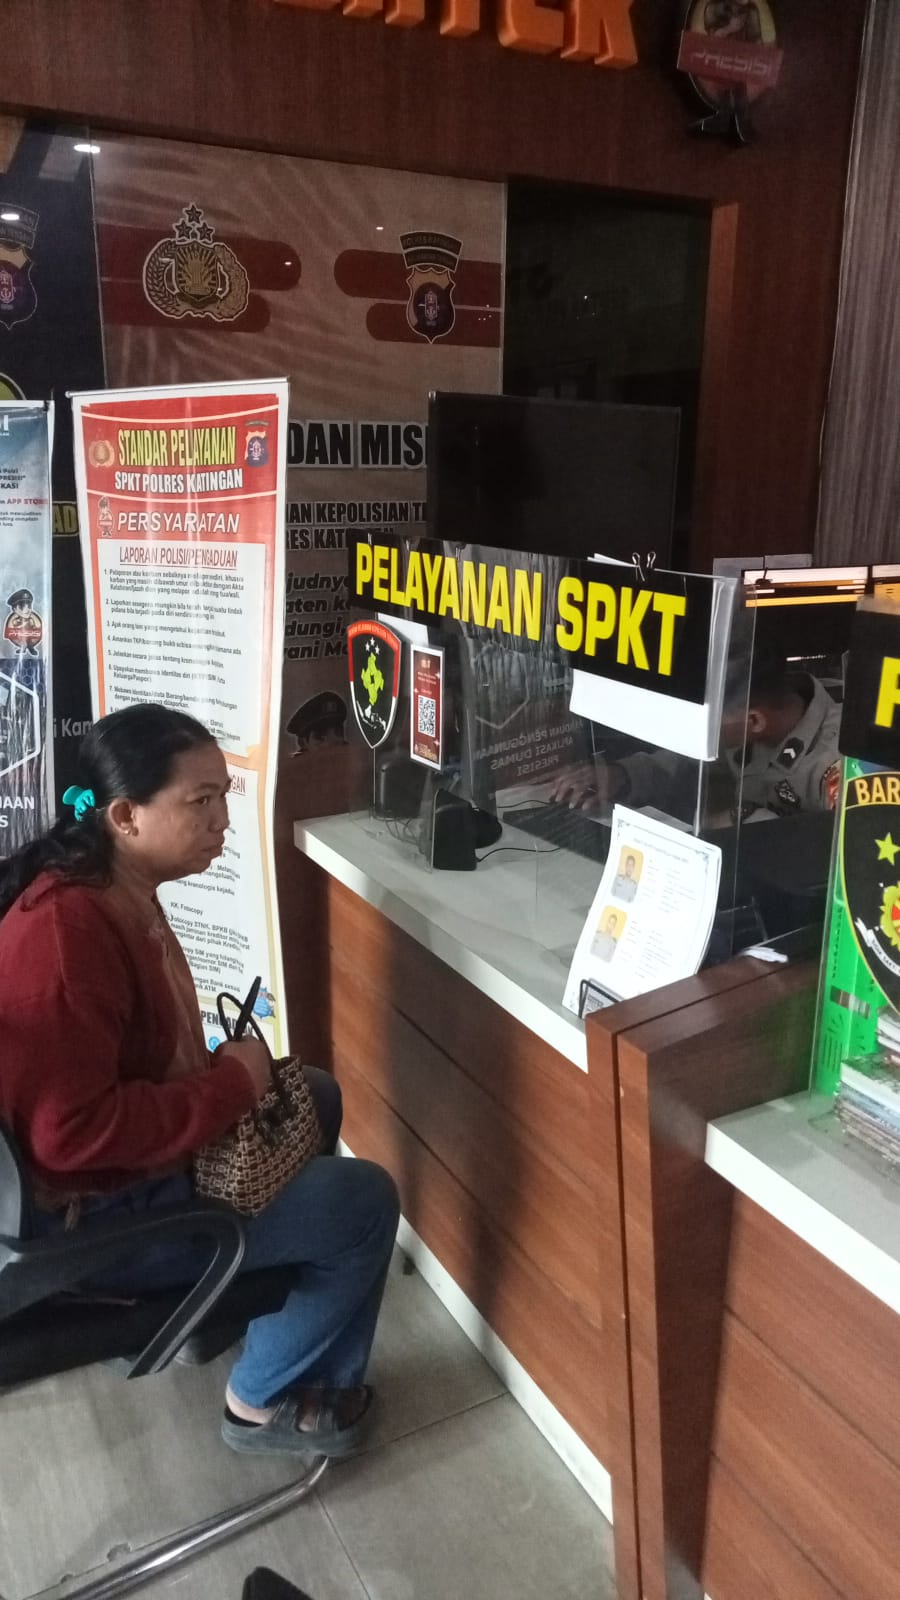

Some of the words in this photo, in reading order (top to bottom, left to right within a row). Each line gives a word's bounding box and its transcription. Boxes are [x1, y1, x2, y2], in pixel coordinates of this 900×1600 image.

[118, 429, 168, 466] STANDAR
[171, 427, 236, 466] PELAYANAN
[288, 422, 351, 465] DAN
[361, 424, 429, 466] MIS
[115, 471, 141, 490] SPKT
[142, 473, 184, 493] POLRES
[186, 469, 243, 492] KATINGAN
[117, 511, 241, 534] PERSYARATAN
[316, 503, 409, 522] KEPOLISIAN
[120, 546, 158, 563] LAPORAN
[356, 542, 542, 642] PELAYANAN
[555, 577, 687, 677] SPKT
